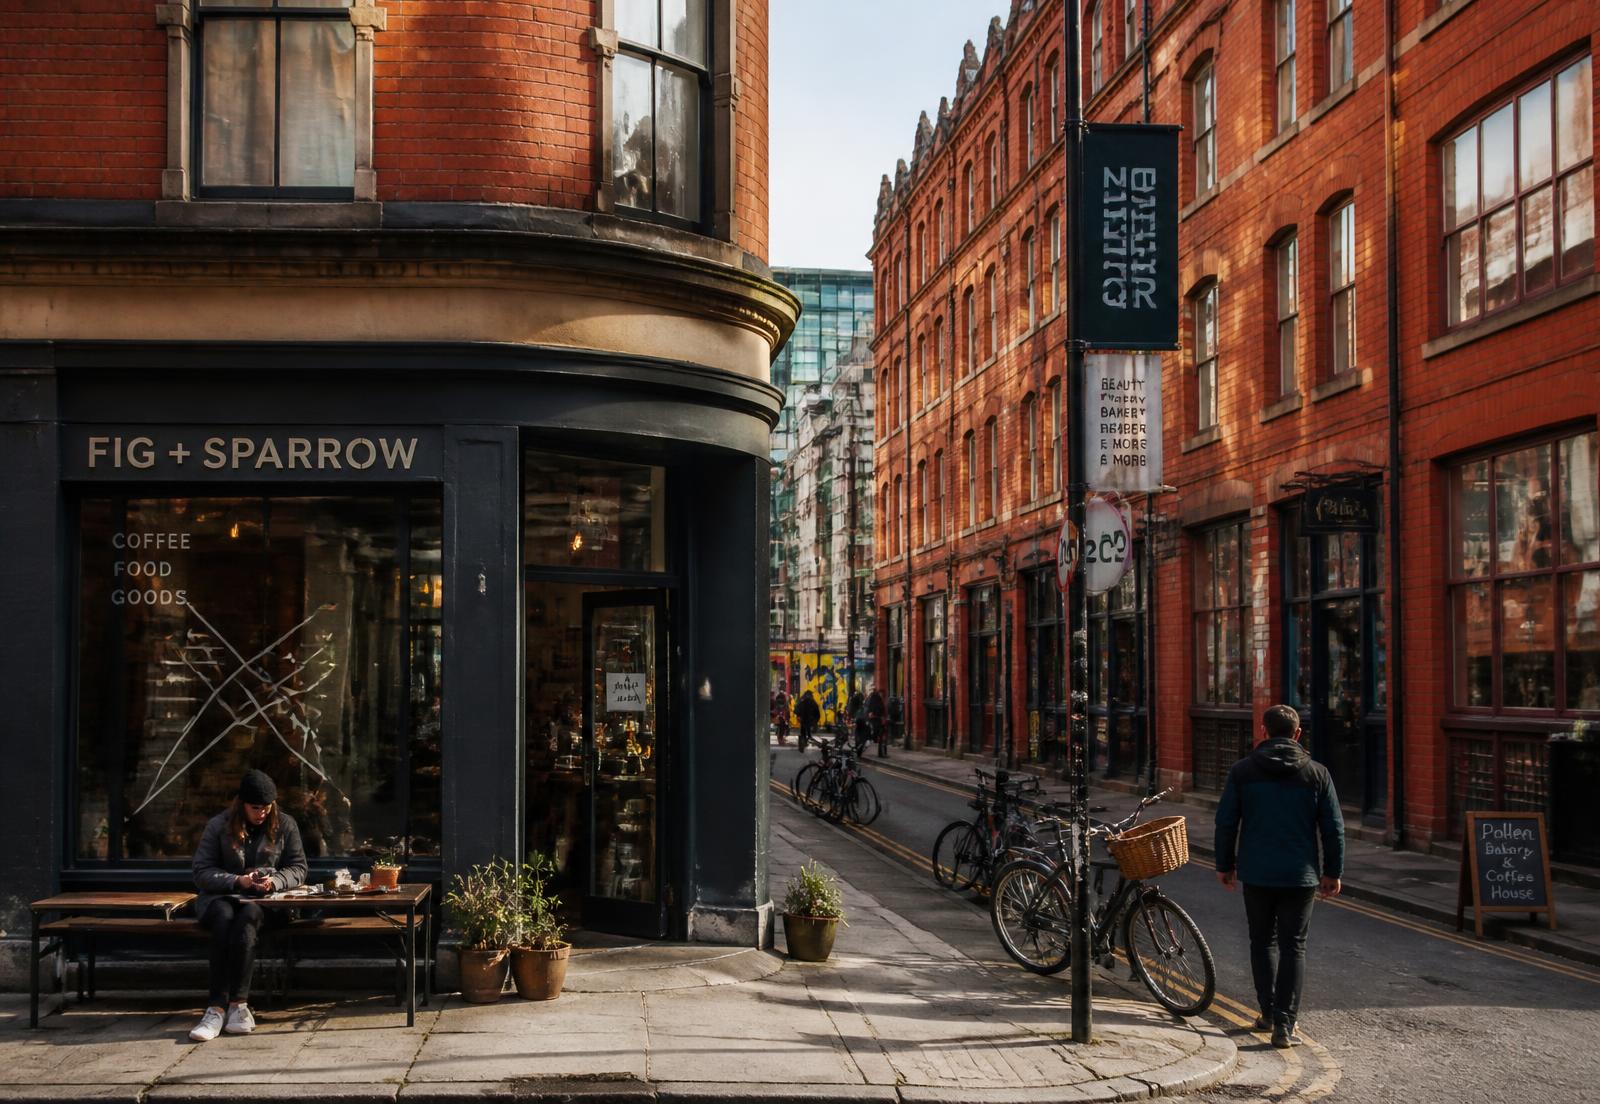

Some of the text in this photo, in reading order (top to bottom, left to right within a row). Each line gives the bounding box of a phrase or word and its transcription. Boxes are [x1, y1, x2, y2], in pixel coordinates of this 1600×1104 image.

[1101, 377, 1145, 391] BEAUTY
[87, 437, 418, 470] FIG + SPARROW
[112, 532, 191, 549] COFFEE
[114, 561, 172, 577] FOOD
[111, 588, 187, 605] GOODS
[1482, 823, 1534, 840] Pollen
[1491, 885, 1535, 900] House
